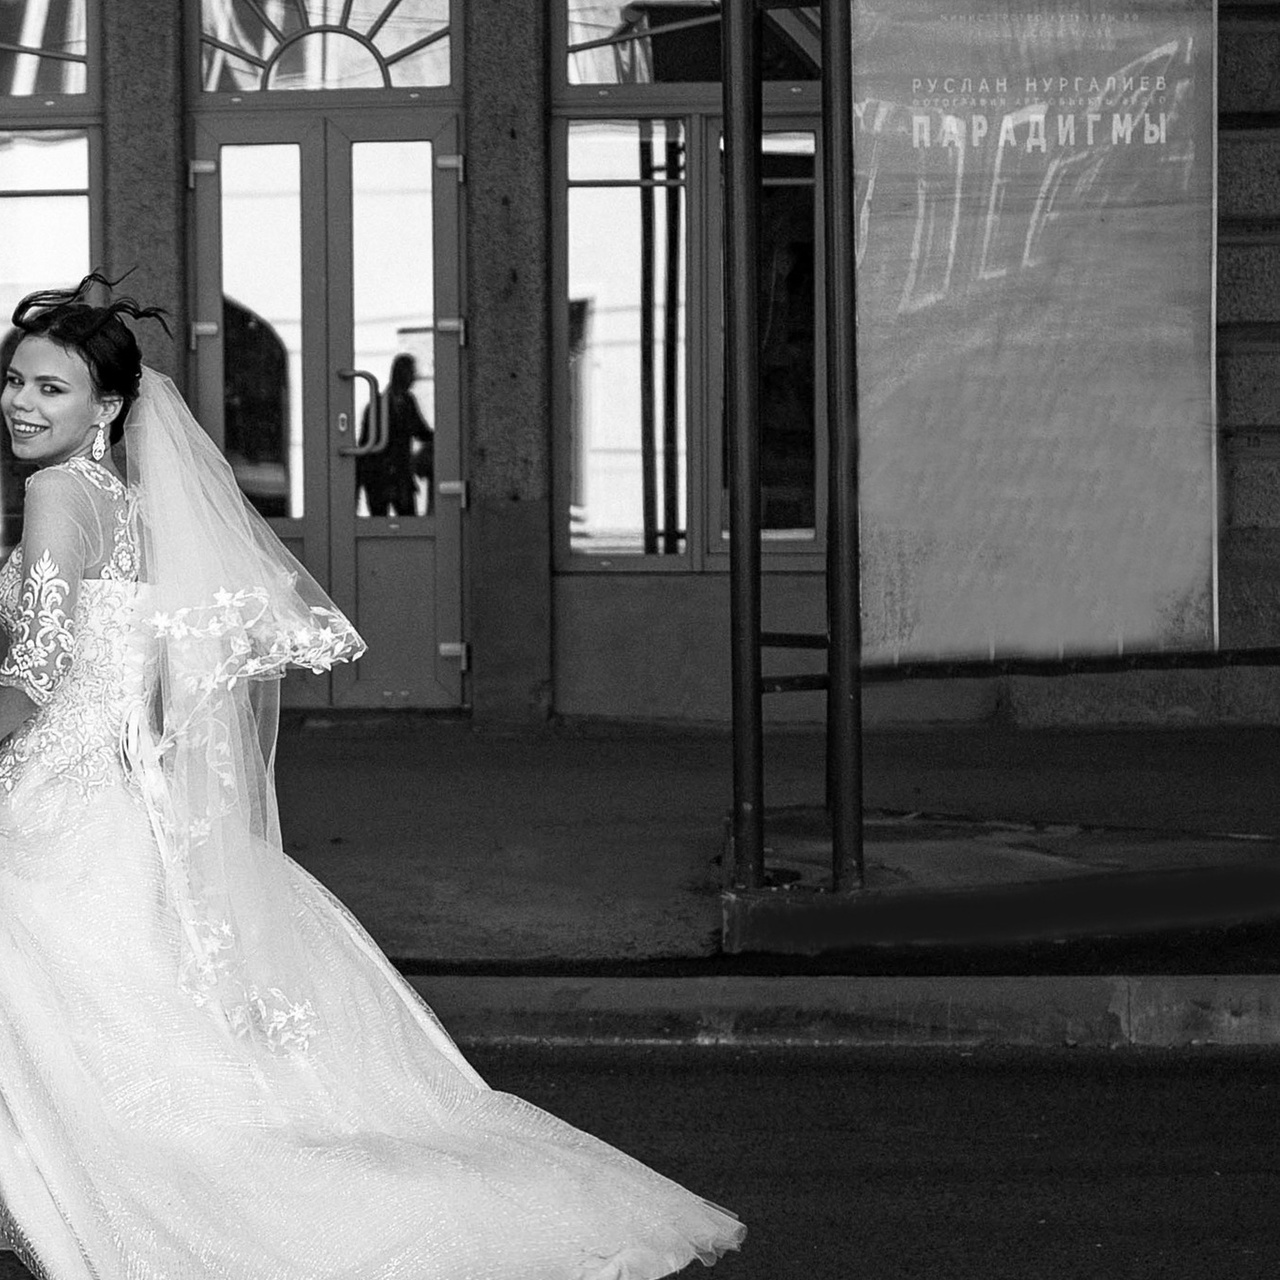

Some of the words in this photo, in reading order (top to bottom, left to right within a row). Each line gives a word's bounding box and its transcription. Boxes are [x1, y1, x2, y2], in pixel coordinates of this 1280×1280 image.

[912, 77, 1007, 93] РУСЛАН
[1025, 76, 1166, 92] НУРГАЛИЕВ
[912, 113, 1167, 153] ПАРАДИГМЫ
